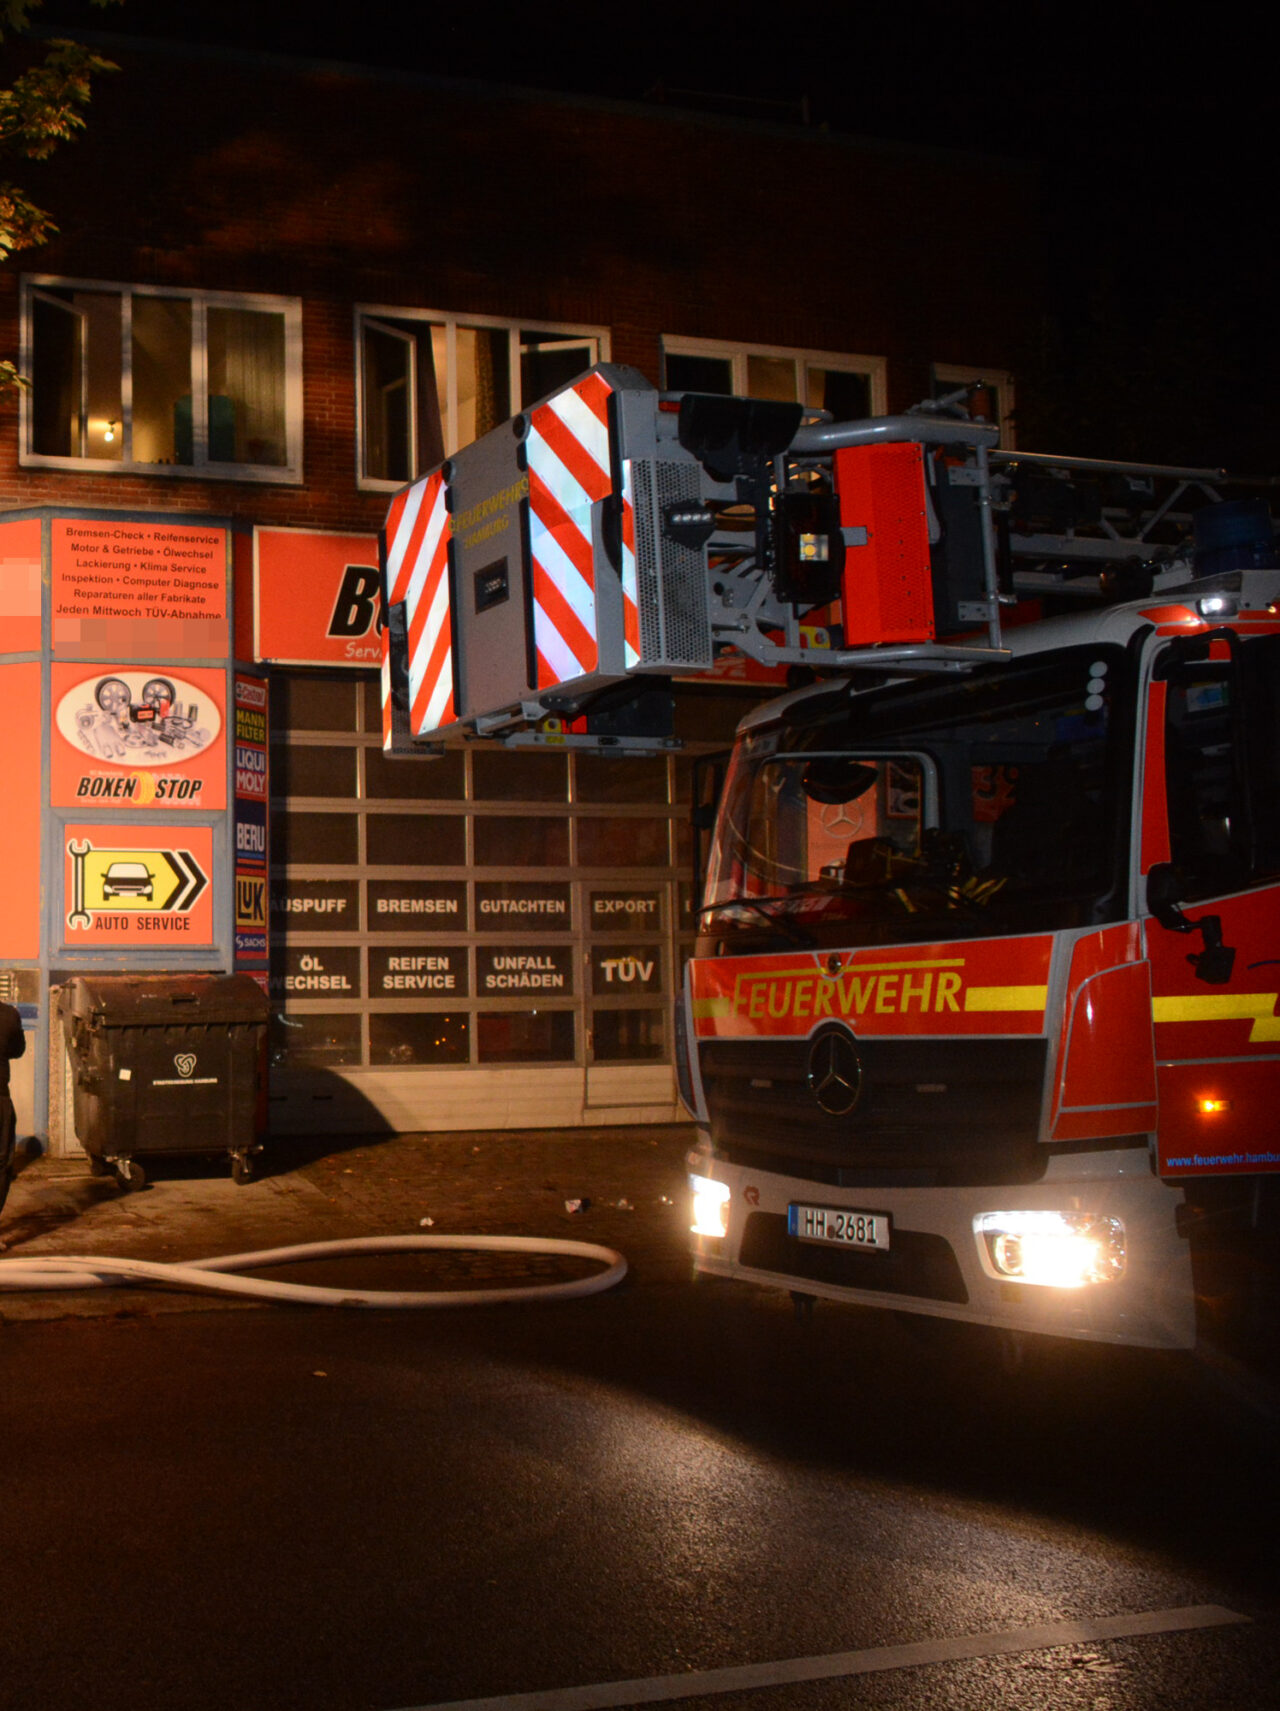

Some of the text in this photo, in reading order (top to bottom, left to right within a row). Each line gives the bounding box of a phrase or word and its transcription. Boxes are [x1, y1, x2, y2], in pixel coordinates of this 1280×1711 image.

[66, 528, 219, 545] Bremsen-Check Reifenservice
[71, 543, 214, 559] Motor & Getriebe Ölwechsel
[76, 559, 206, 574] Lackierung Klima Service
[62, 573, 219, 590] Inspektion Computer Diagnose
[74, 589, 206, 604] Reparaturen aller Fabrikate
[325, 563, 382, 640] B
[56, 604, 221, 619] Jeden Mittwoch TÜV-Abnahme
[236, 709, 265, 728] MANN
[236, 724, 265, 743] FILTER
[236, 748, 265, 772] LIQUI
[76, 777, 202, 799] BOXEN STOP
[236, 770, 265, 793] MOLY
[236, 822, 265, 852] BERU
[376, 899, 458, 913] BREMSEN
[480, 899, 566, 913] GUTACHTEN
[594, 900, 656, 913] EXPORT
[95, 916, 191, 931] AUTO SERVICE
[244, 938, 266, 948] SACHS
[300, 954, 324, 972] ÖL
[389, 957, 449, 970] REIFEN
[493, 956, 556, 970] UNFALL
[600, 958, 654, 983] TÜV
[383, 975, 456, 989] SERVICE
[486, 972, 564, 987] SCHÄDEN
[732, 968, 964, 1020] FEUERWEHR
[1166, 1152, 1280, 1168] www.feuerwehr.hambu
[805, 1210, 877, 1244] HH 2681
